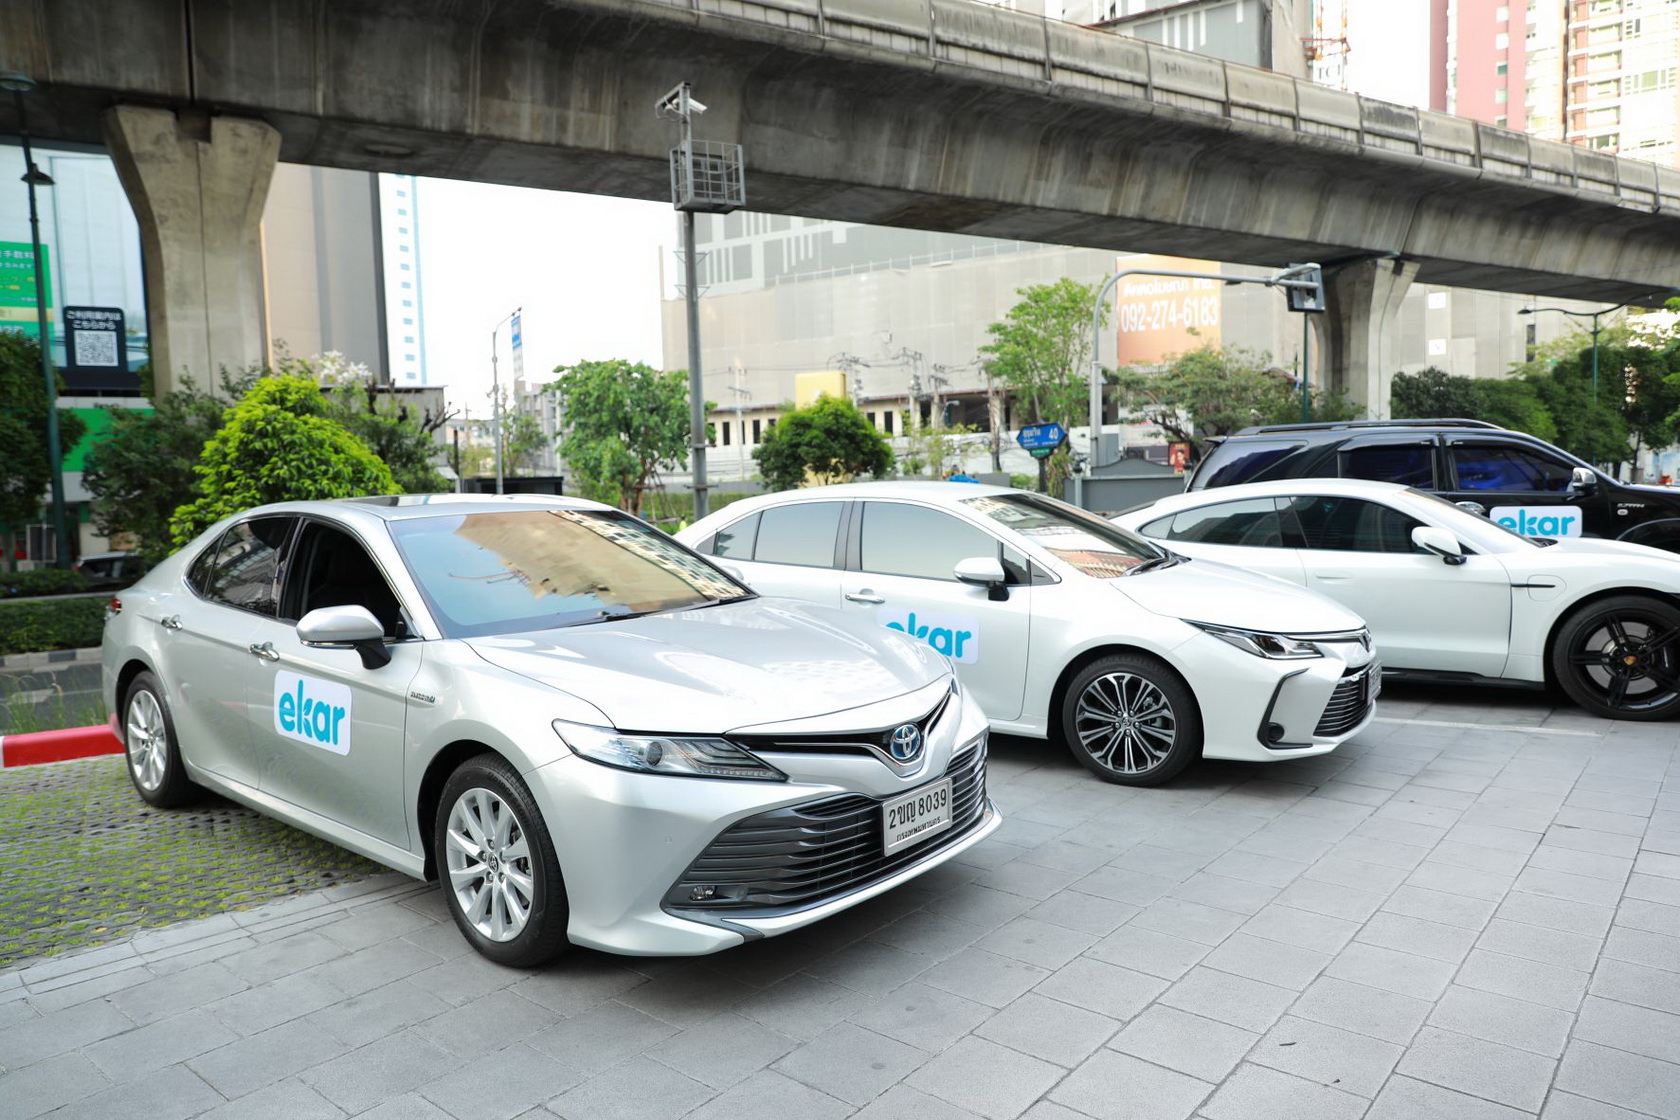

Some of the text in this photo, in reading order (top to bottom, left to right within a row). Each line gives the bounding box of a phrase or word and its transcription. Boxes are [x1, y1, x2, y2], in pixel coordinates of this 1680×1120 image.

[1121, 296, 1219, 333] 092-274-6183
[1049, 428, 1059, 440] 40
[279, 679, 346, 746] ekar
[918, 788, 948, 816] 8039
